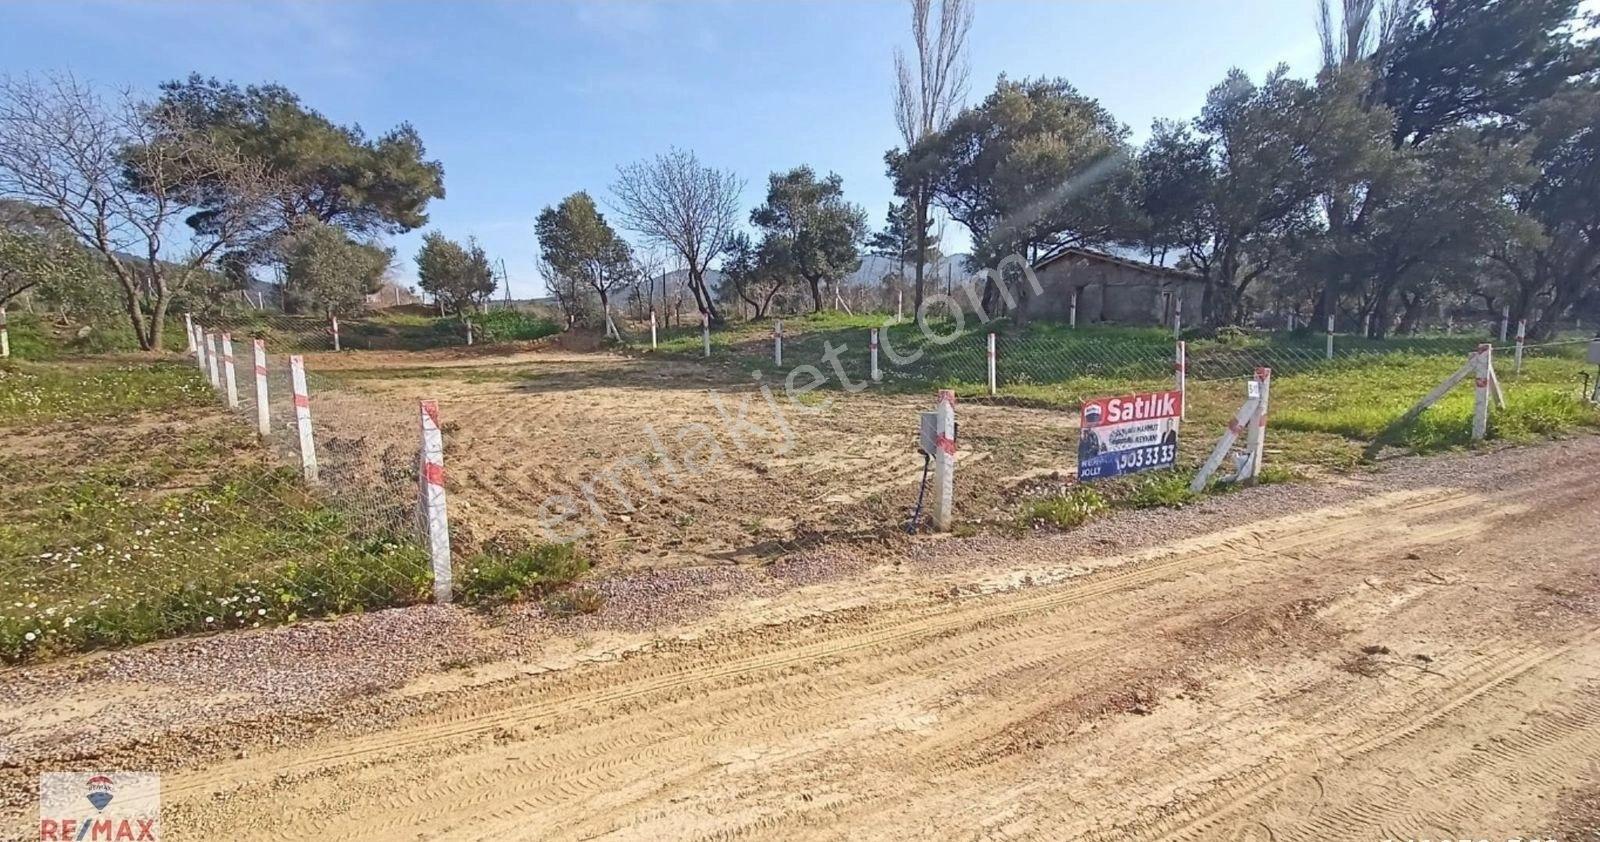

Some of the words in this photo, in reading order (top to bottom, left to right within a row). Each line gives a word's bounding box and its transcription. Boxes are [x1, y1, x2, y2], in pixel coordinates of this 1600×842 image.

[1107, 393, 1175, 422] Satılık
[1146, 446, 1159, 465] 33
[1161, 445, 1175, 462] 33
